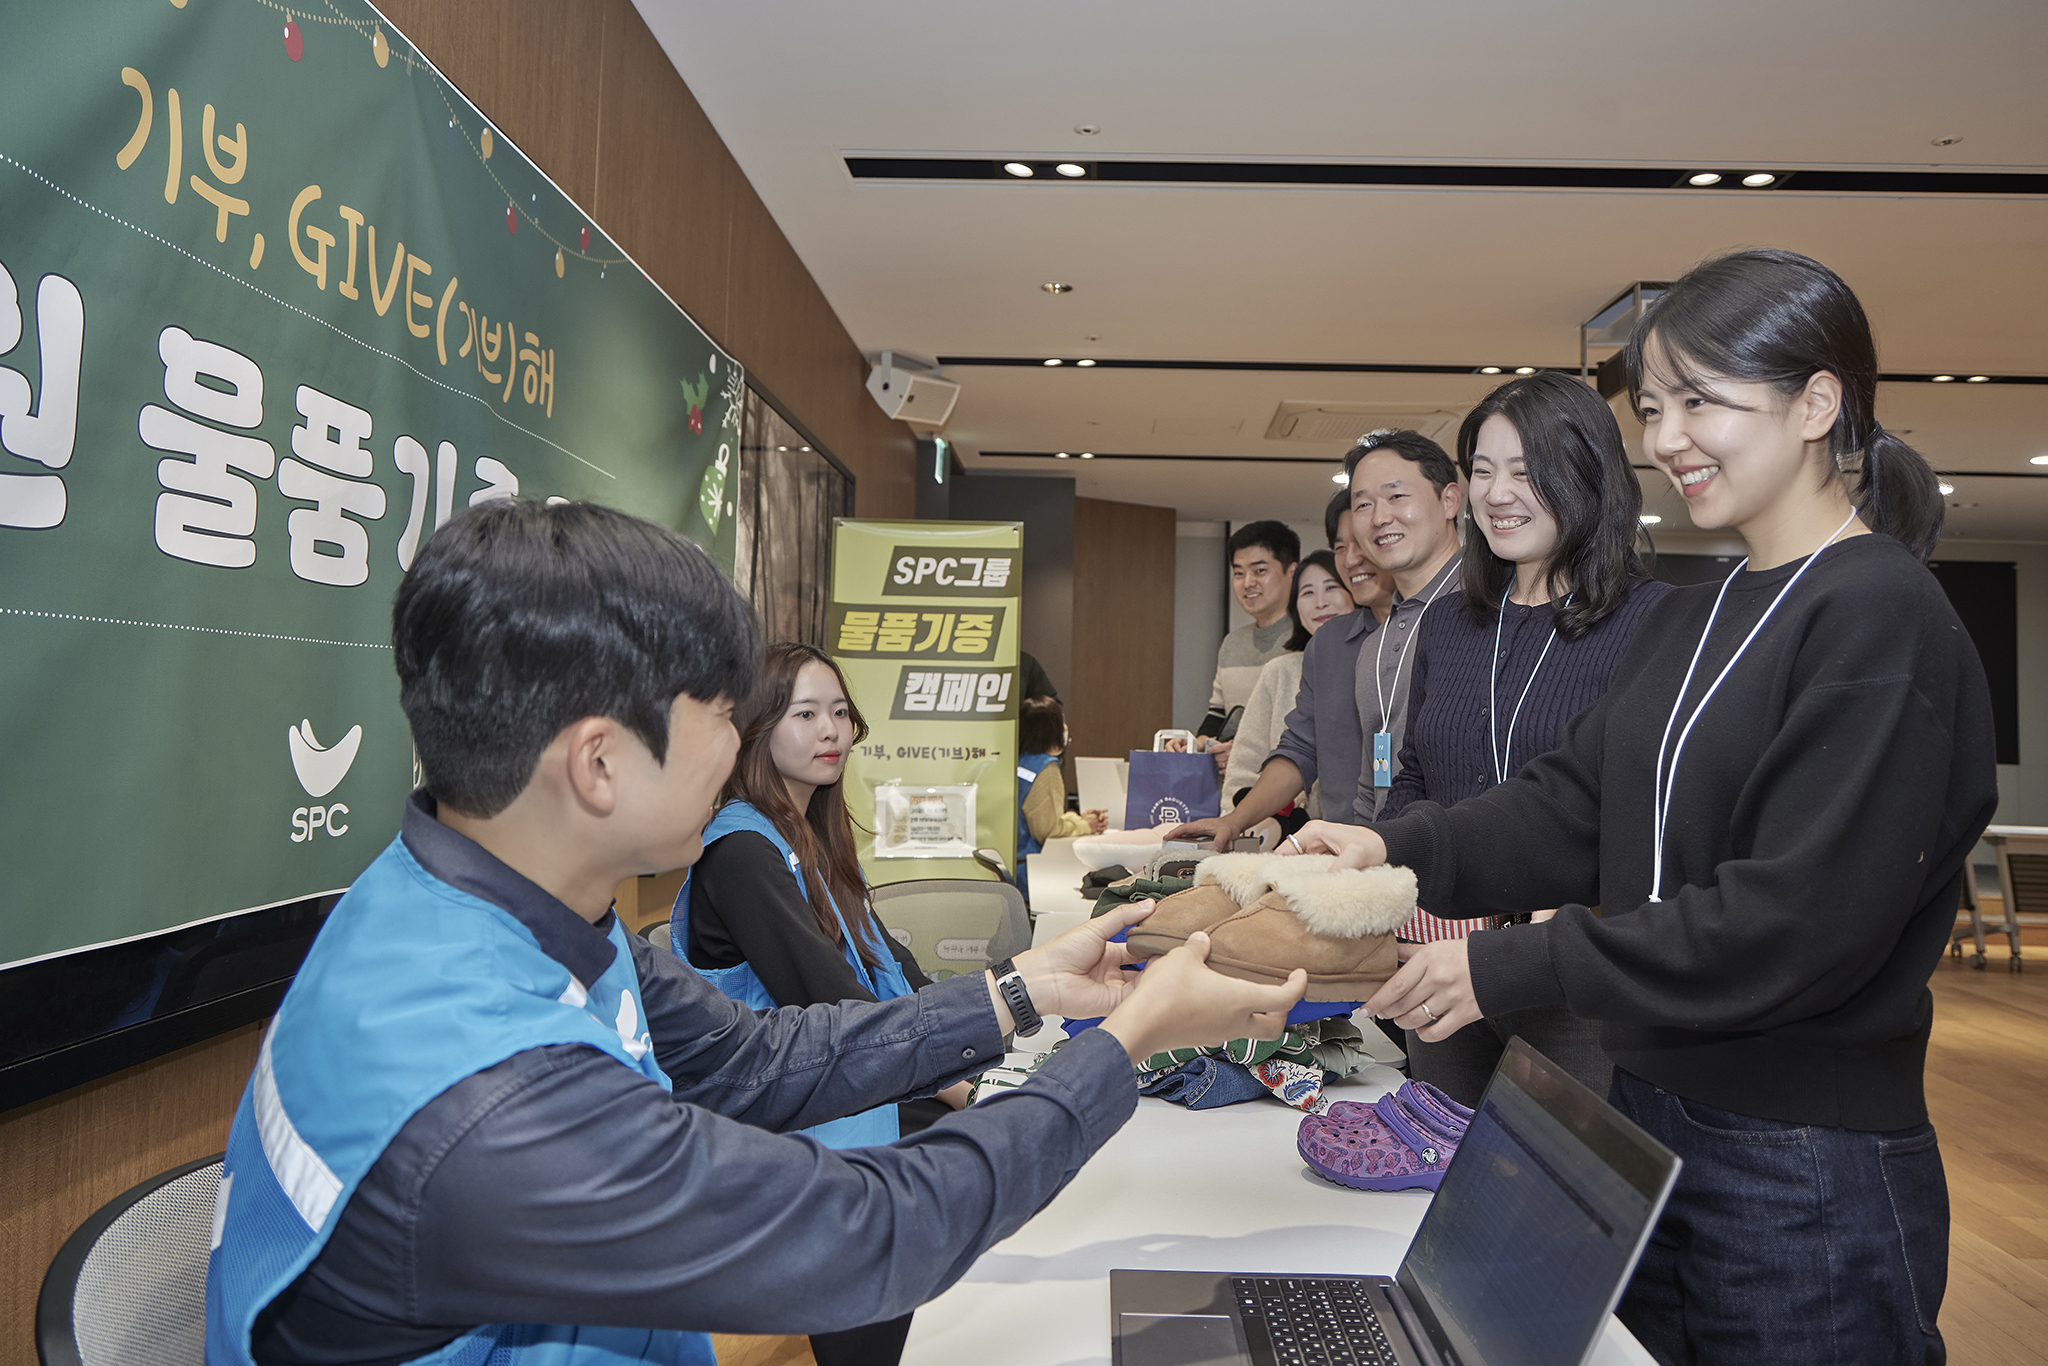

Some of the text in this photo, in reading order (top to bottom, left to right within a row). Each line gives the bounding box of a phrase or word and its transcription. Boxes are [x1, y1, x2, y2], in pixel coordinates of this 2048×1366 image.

[116, 66, 556, 419] 기부, GIVE(기브)해
[137, 325, 521, 588] 물품기
[892, 556, 1012, 588] SPC그룹
[837, 610, 994, 654] 물품기증
[903, 672, 1012, 713] 캠페인
[859, 744, 986, 761] 기부, GIVE(기브)해
[290, 802, 349, 843] SPC
